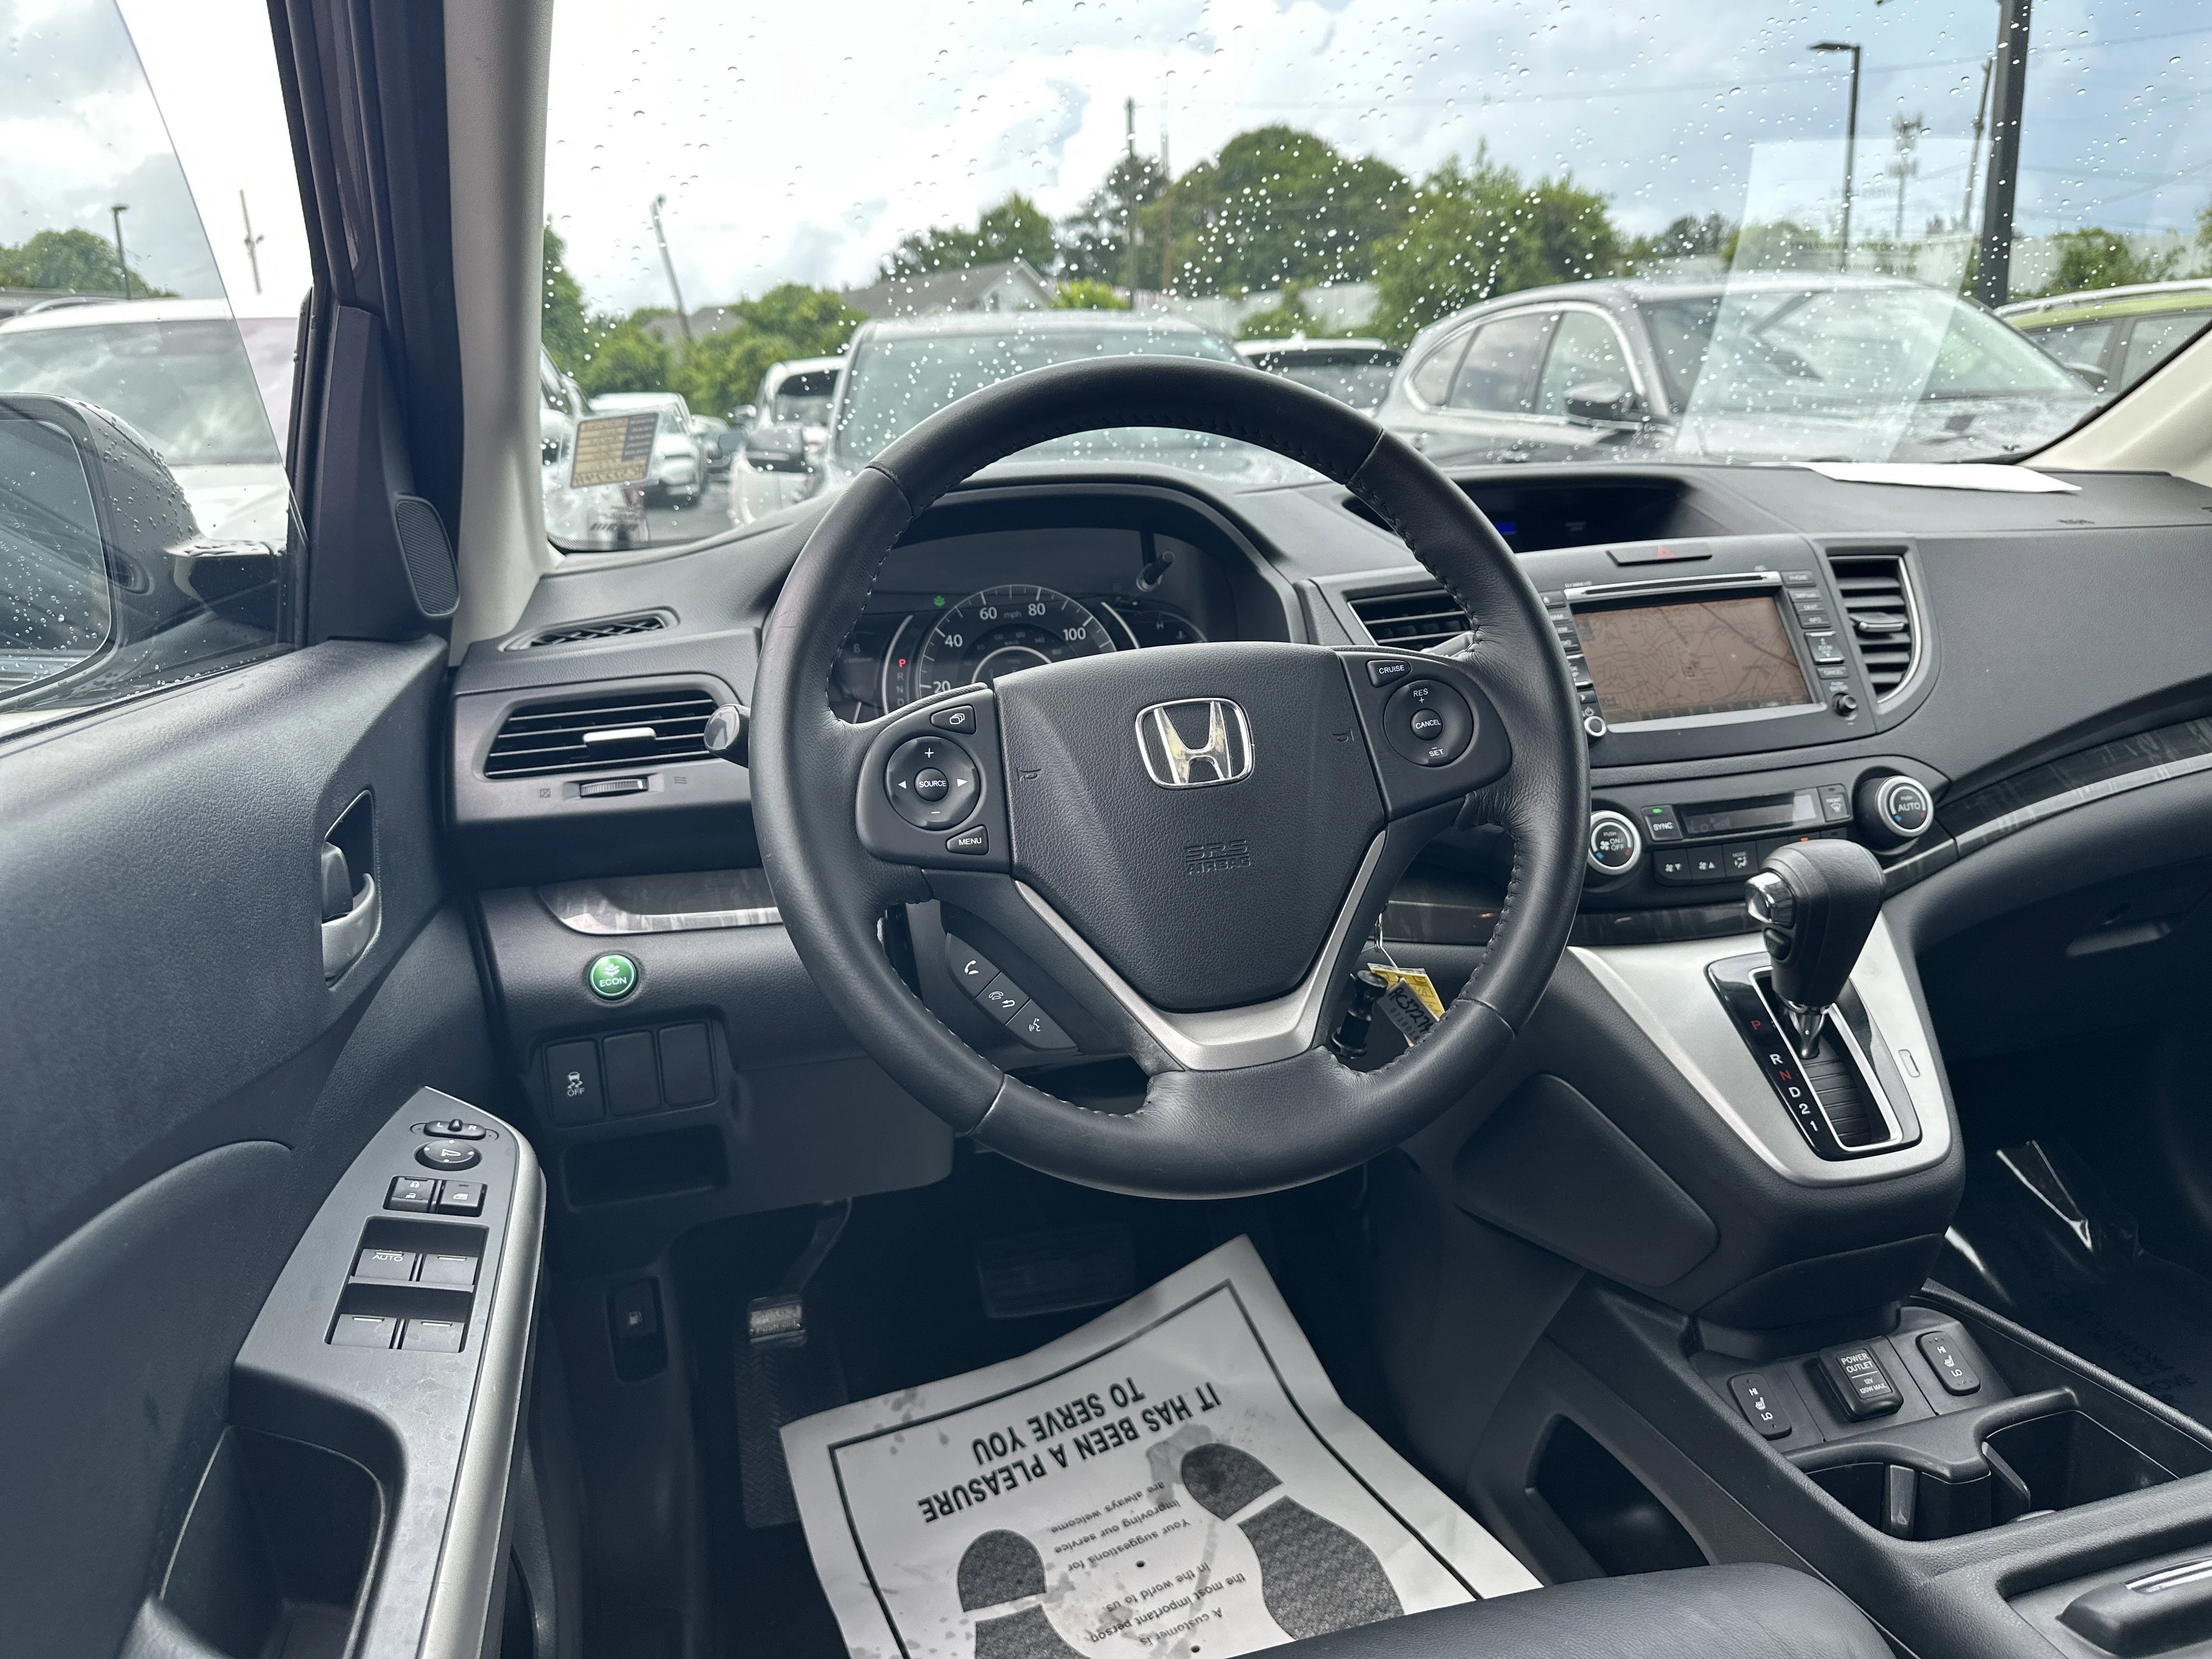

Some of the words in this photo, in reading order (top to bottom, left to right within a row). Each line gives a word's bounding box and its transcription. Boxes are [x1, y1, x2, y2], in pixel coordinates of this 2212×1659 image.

[979, 606, 997, 620] 60
[1028, 602, 1046, 617] 80
[1063, 627, 1087, 641] 100
[945, 633, 963, 648] 40
[898, 658, 906, 668] P
[1379, 664, 1405, 674] CRUISE
[897, 672, 904, 681] R
[933, 680, 951, 693] 20
[1413, 688, 1429, 697] RES
[1415, 719, 1441, 730] CANCEL
[1429, 748, 1443, 757] SET
[1898, 802, 1921, 812] AUTO
[1653, 822, 1674, 831] SYNC
[958, 837, 981, 845] MENU
[1185, 839, 1248, 859] SRS
[599, 976, 628, 988] ECON
[1750, 1019, 1763, 1030] P
[1769, 1053, 1783, 1065] R
[1779, 1070, 1792, 1081] N
[567, 1087, 585, 1097] OFF
[1788, 1086, 1802, 1098] D
[1798, 1103, 1810, 1115] 2
[1810, 1121, 1819, 1132] 1
[372, 1254, 404, 1262] AUTO
[1937, 1346, 1946, 1354] HI
[1841, 1352, 1869, 1365] POWER
[1846, 1361, 1874, 1373] OUTLET
[1951, 1369, 1962, 1377] LO
[1108, 1376, 1147, 1408] TO
[1748, 1387, 1759, 1396] HI
[1859, 1385, 1874, 1394] 120W
[1194, 1381, 1222, 1412] IT
[1026, 1392, 1107, 1442] SERVE
[1141, 1393, 1194, 1432] HAS
[1760, 1412, 1773, 1421] LO
[1073, 1415, 1141, 1460] BEEN
[971, 1425, 1028, 1465] YOU
[1047, 1442, 1068, 1468] A
[917, 1453, 1048, 1523] PLEASURE
[1146, 1481, 1165, 1493] are
[1104, 1491, 1143, 1513] always
[1122, 1499, 1182, 1528] improving
[1100, 1525, 1120, 1537] our
[1162, 1518, 1192, 1534] Your
[1054, 1533, 1097, 1553] service
[1087, 1531, 1159, 1564] suggestions
[1067, 1559, 1085, 1572] for
[1175, 1570, 1196, 1583] the
[1226, 1572, 1247, 1585] the
[1140, 1579, 1174, 1601] world
[1193, 1581, 1224, 1601] most
[1125, 1594, 1138, 1604] to
[1135, 1595, 1193, 1626] important
[1211, 1607, 1223, 1619] A
[1090, 1618, 1133, 1643] person
[1155, 1613, 1210, 1640] customer
[1139, 1636, 1154, 1646] is
